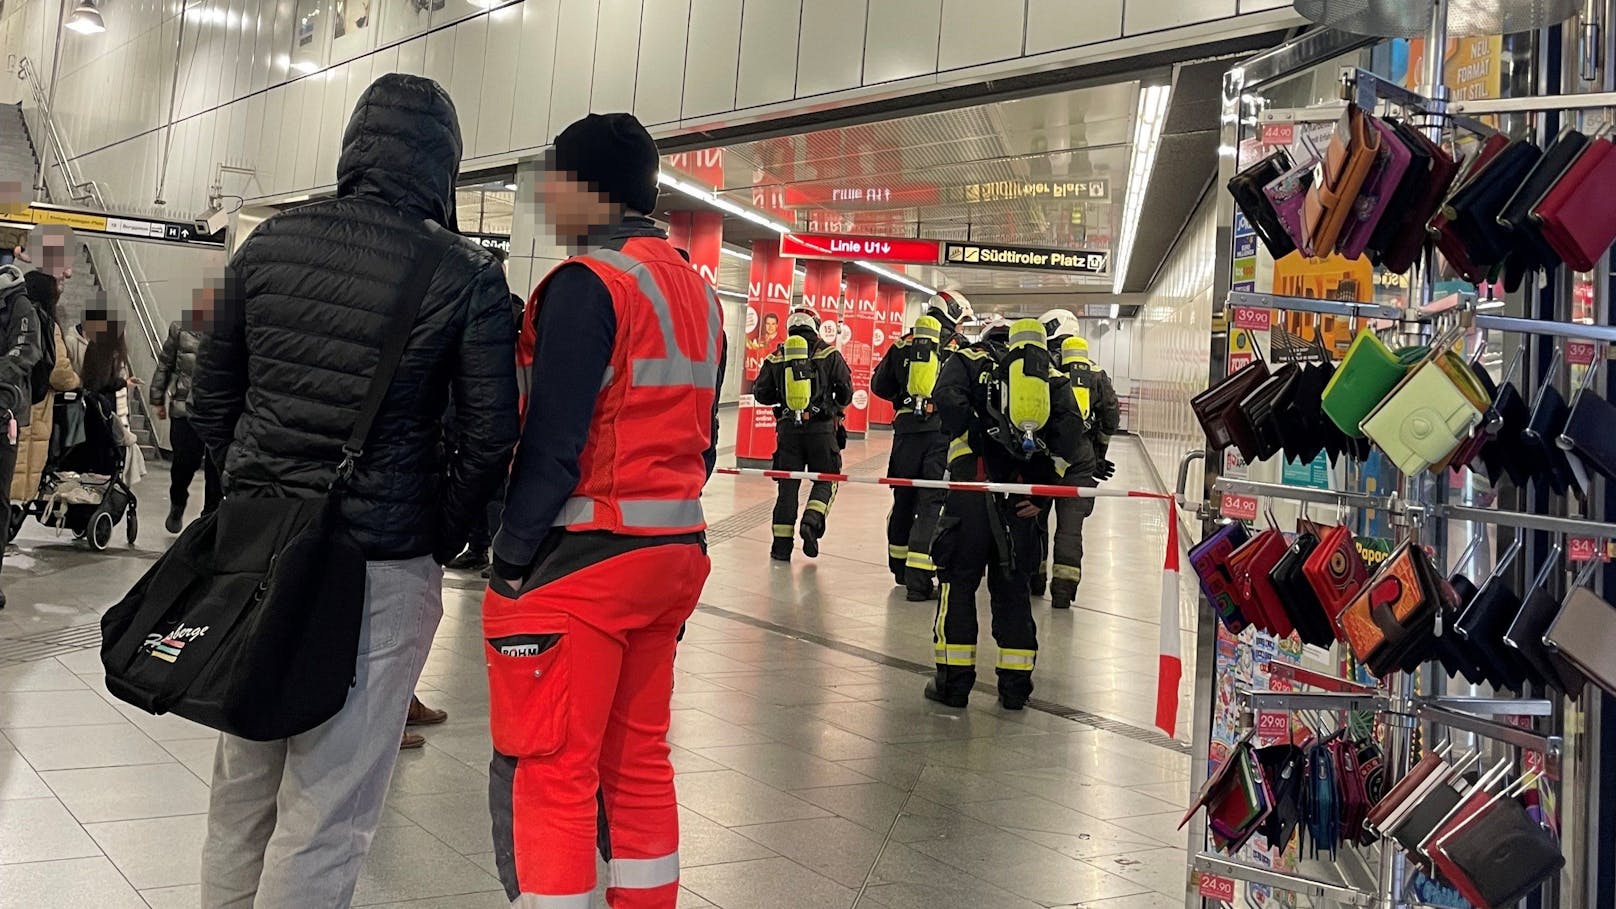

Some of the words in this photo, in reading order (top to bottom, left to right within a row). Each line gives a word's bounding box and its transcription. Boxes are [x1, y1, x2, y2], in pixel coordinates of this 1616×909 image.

[1471, 40, 1490, 59] NEU.
[1457, 59, 1489, 84] FORMAT
[1468, 81, 1488, 100] STIL.
[1265, 127, 1291, 137] 44.90
[169, 227, 177, 236] H
[831, 239, 862, 253] Linie
[864, 241, 880, 254] U1
[980, 249, 1048, 266] Südtiroler
[1050, 253, 1086, 268] Platz
[767, 282, 791, 301] IN
[821, 295, 839, 310] IN
[859, 300, 875, 312] IN
[890, 311, 904, 322] IN
[1239, 309, 1268, 323] 39.90
[1224, 496, 1256, 511] 34.90
[1271, 680, 1292, 692] 29.90
[1260, 715, 1286, 728] 29.90
[1201, 876, 1231, 893] 24.90
